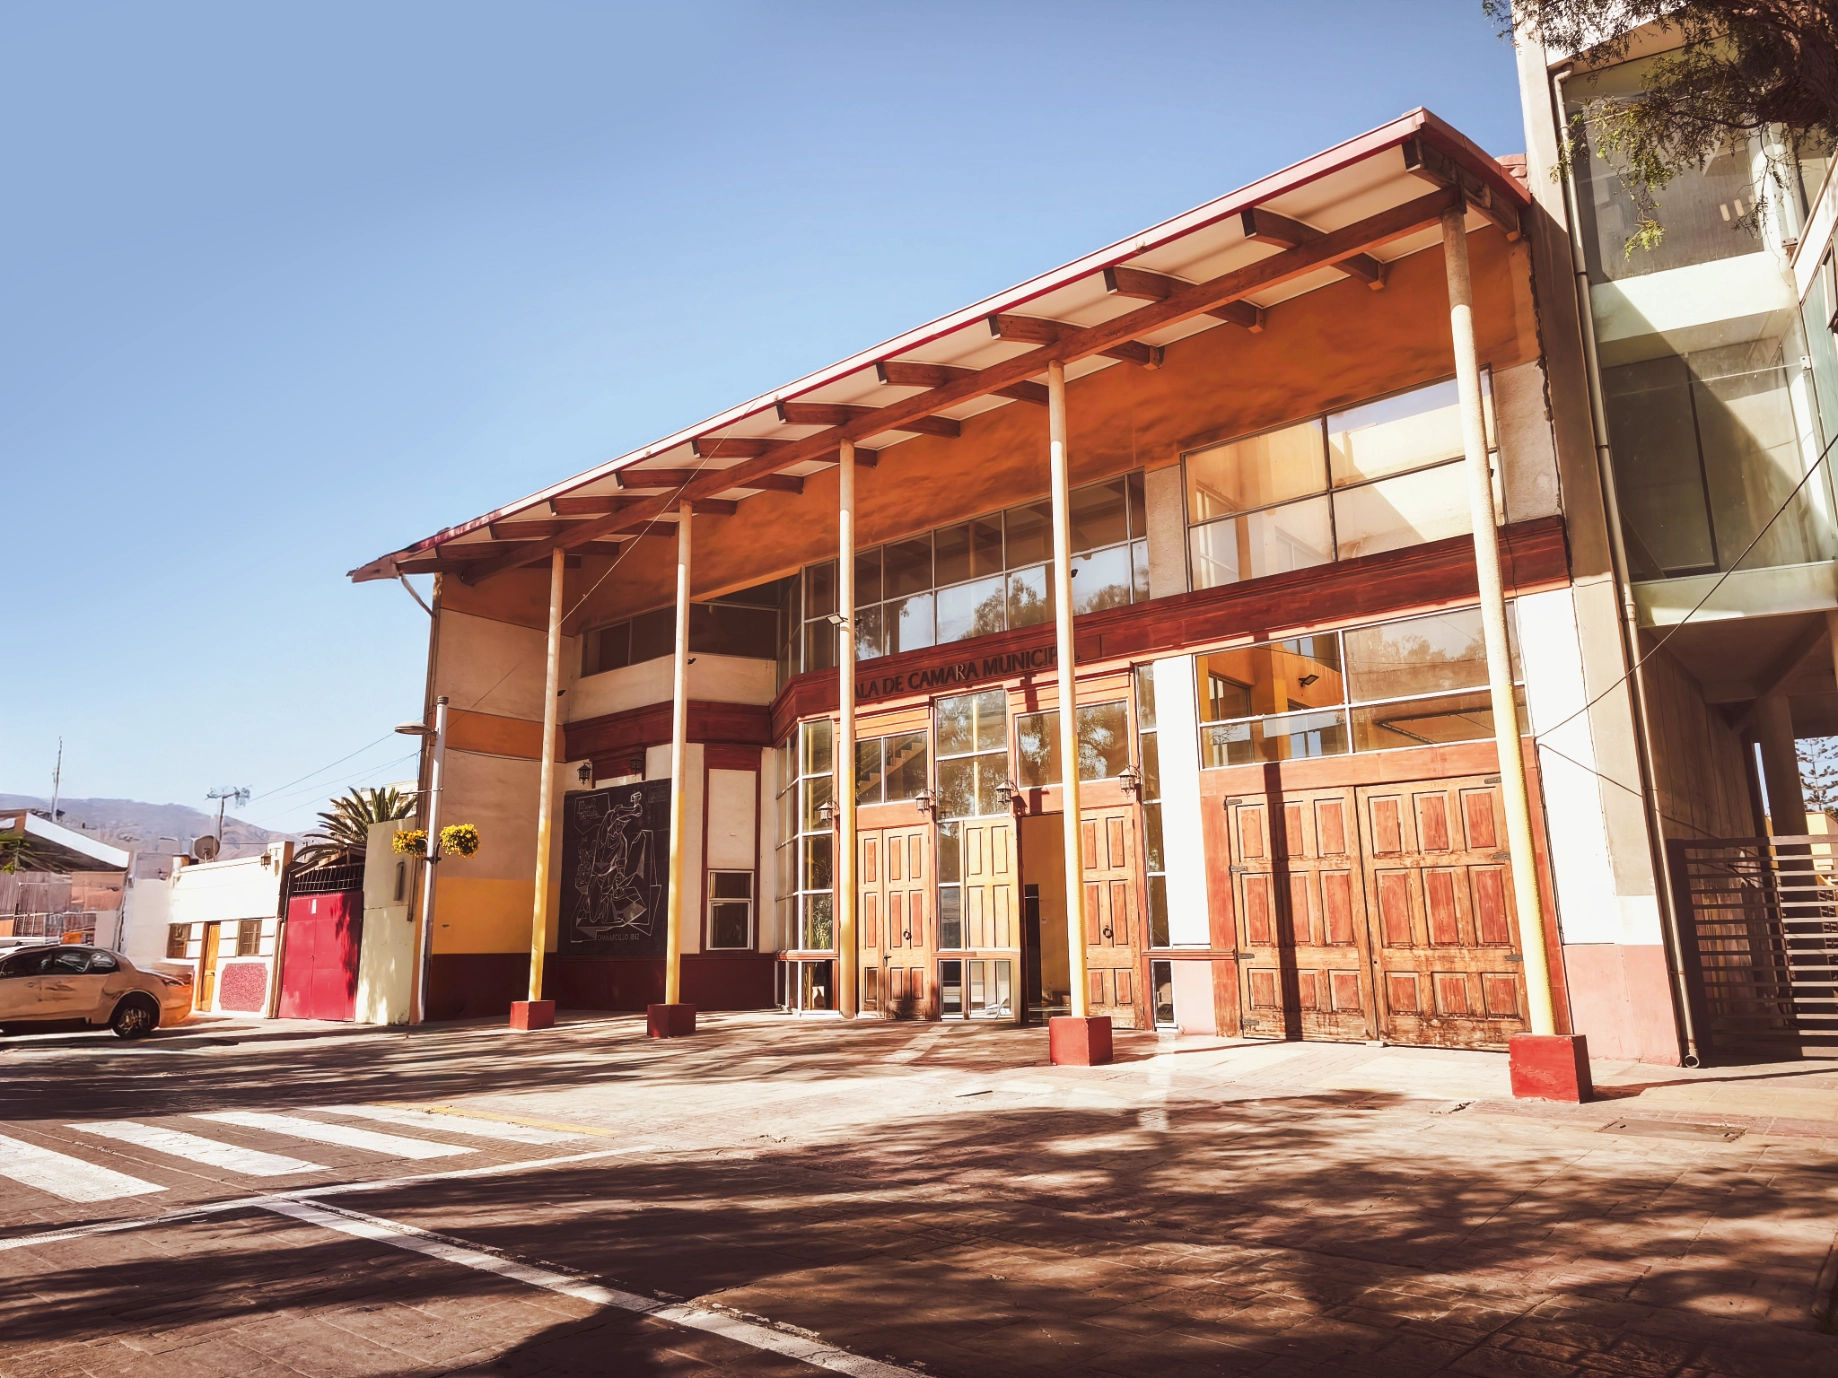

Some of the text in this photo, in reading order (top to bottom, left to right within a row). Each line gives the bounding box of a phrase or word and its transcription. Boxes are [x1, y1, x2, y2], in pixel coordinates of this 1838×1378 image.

[855, 647, 1080, 698] ALA DE CAMARA MUNICIP
